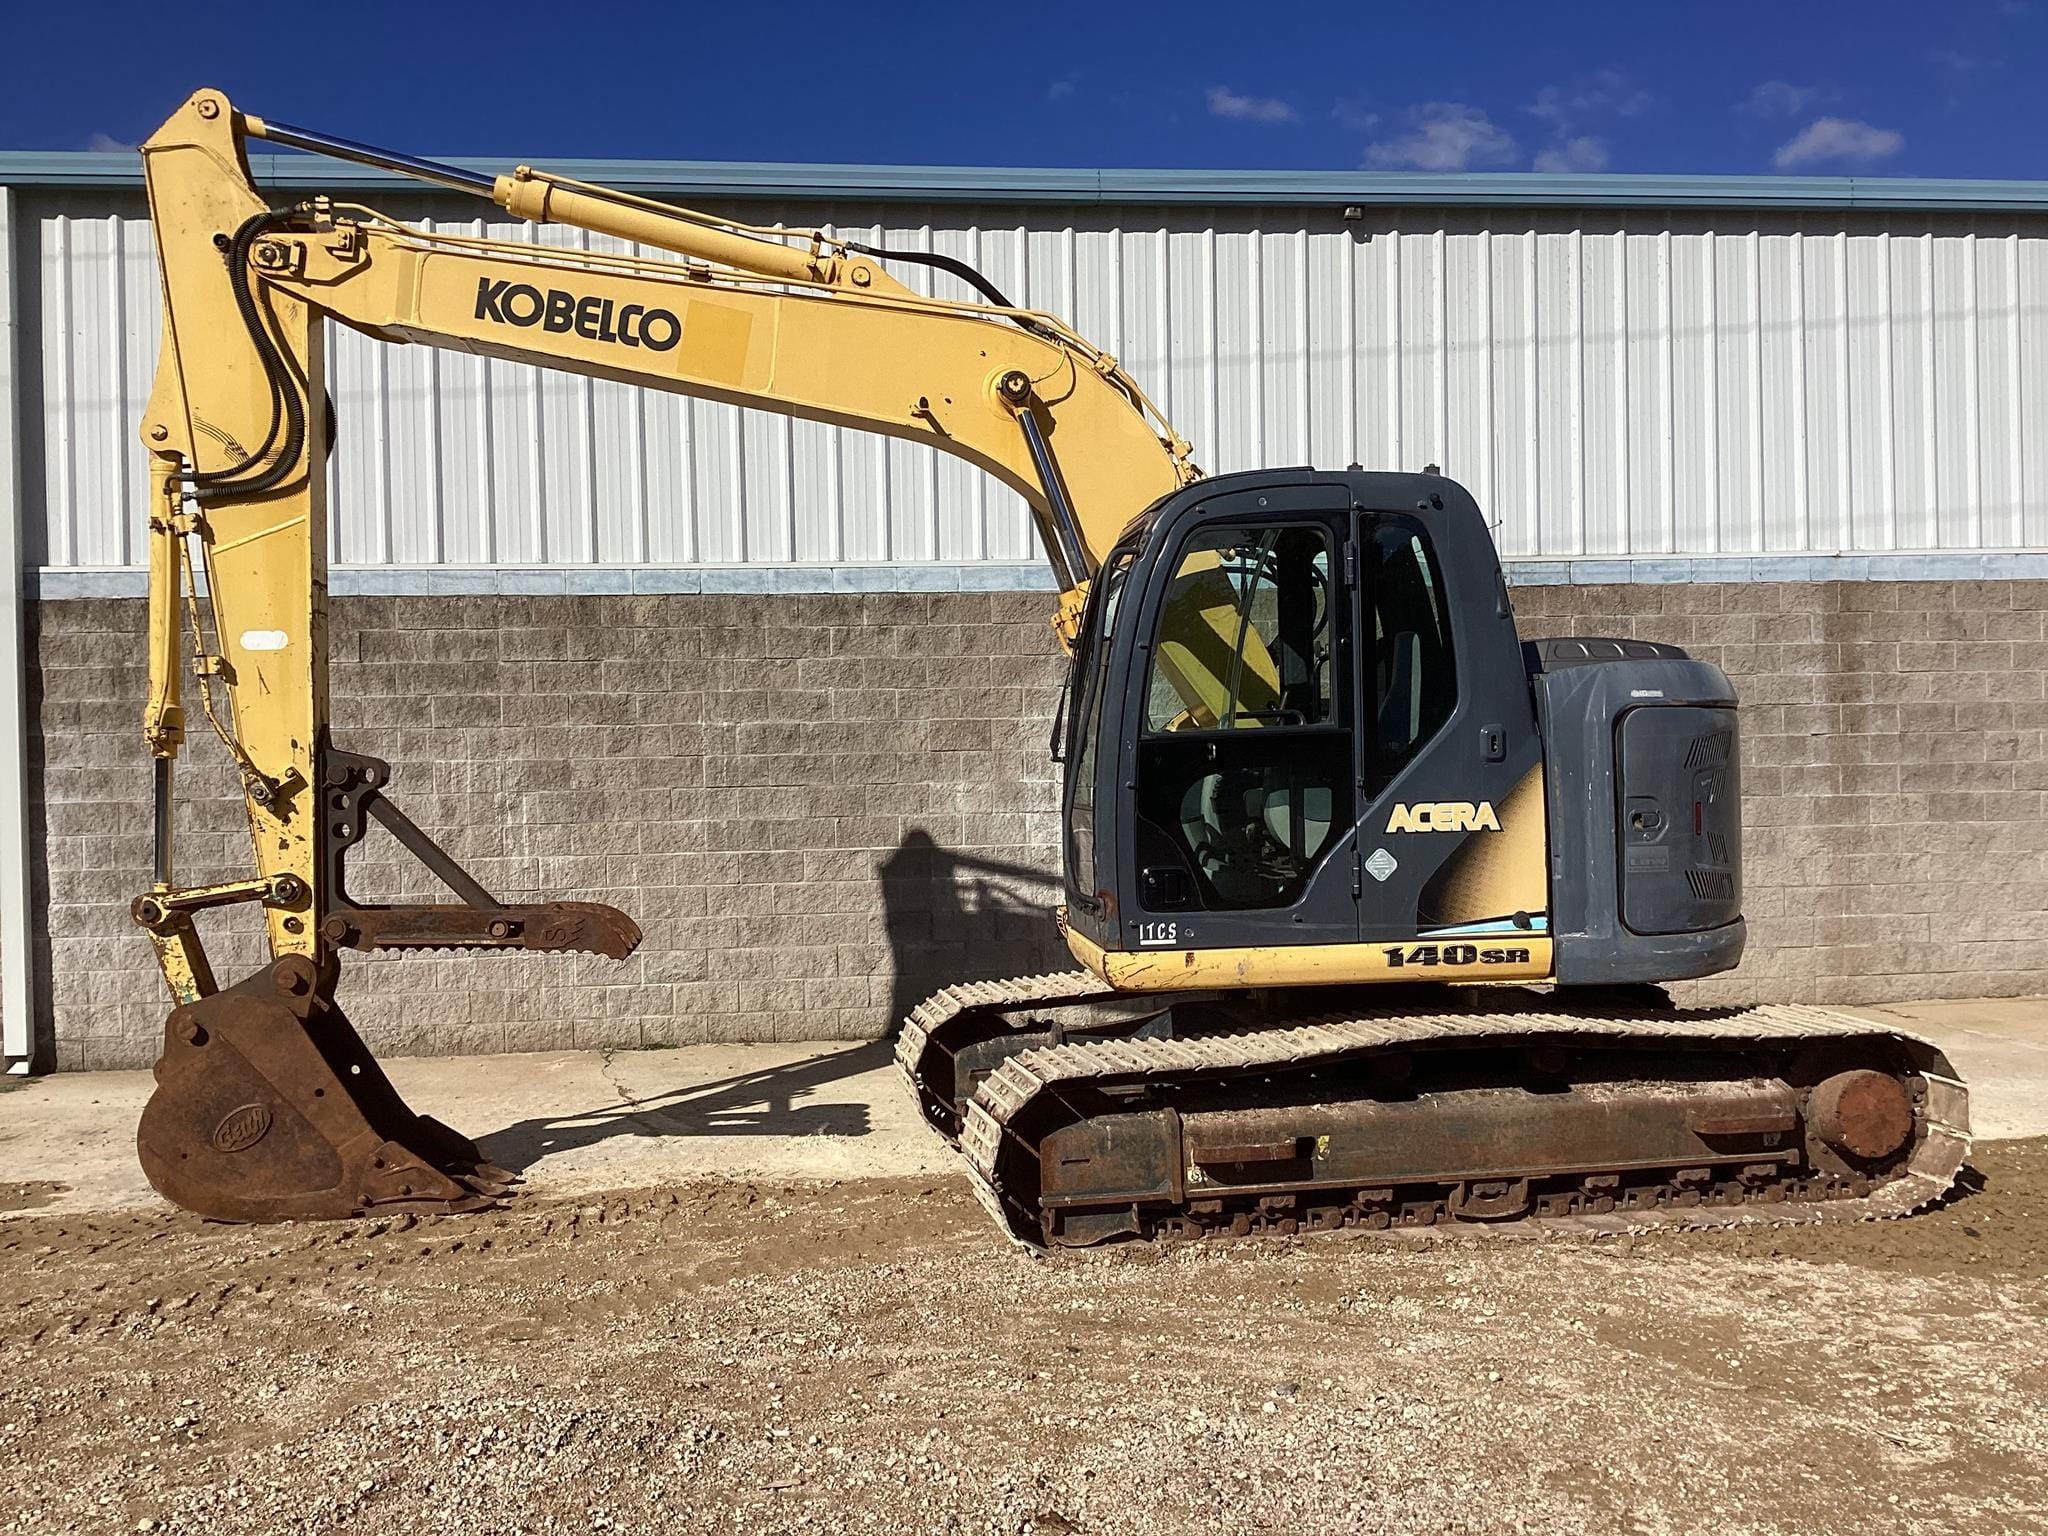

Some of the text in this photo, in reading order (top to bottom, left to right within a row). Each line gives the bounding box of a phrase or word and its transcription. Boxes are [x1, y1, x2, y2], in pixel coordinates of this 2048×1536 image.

[474, 276, 682, 352] KOBELCO
[1384, 801, 1502, 834] ACERA
[1139, 921, 1177, 940] ITCS
